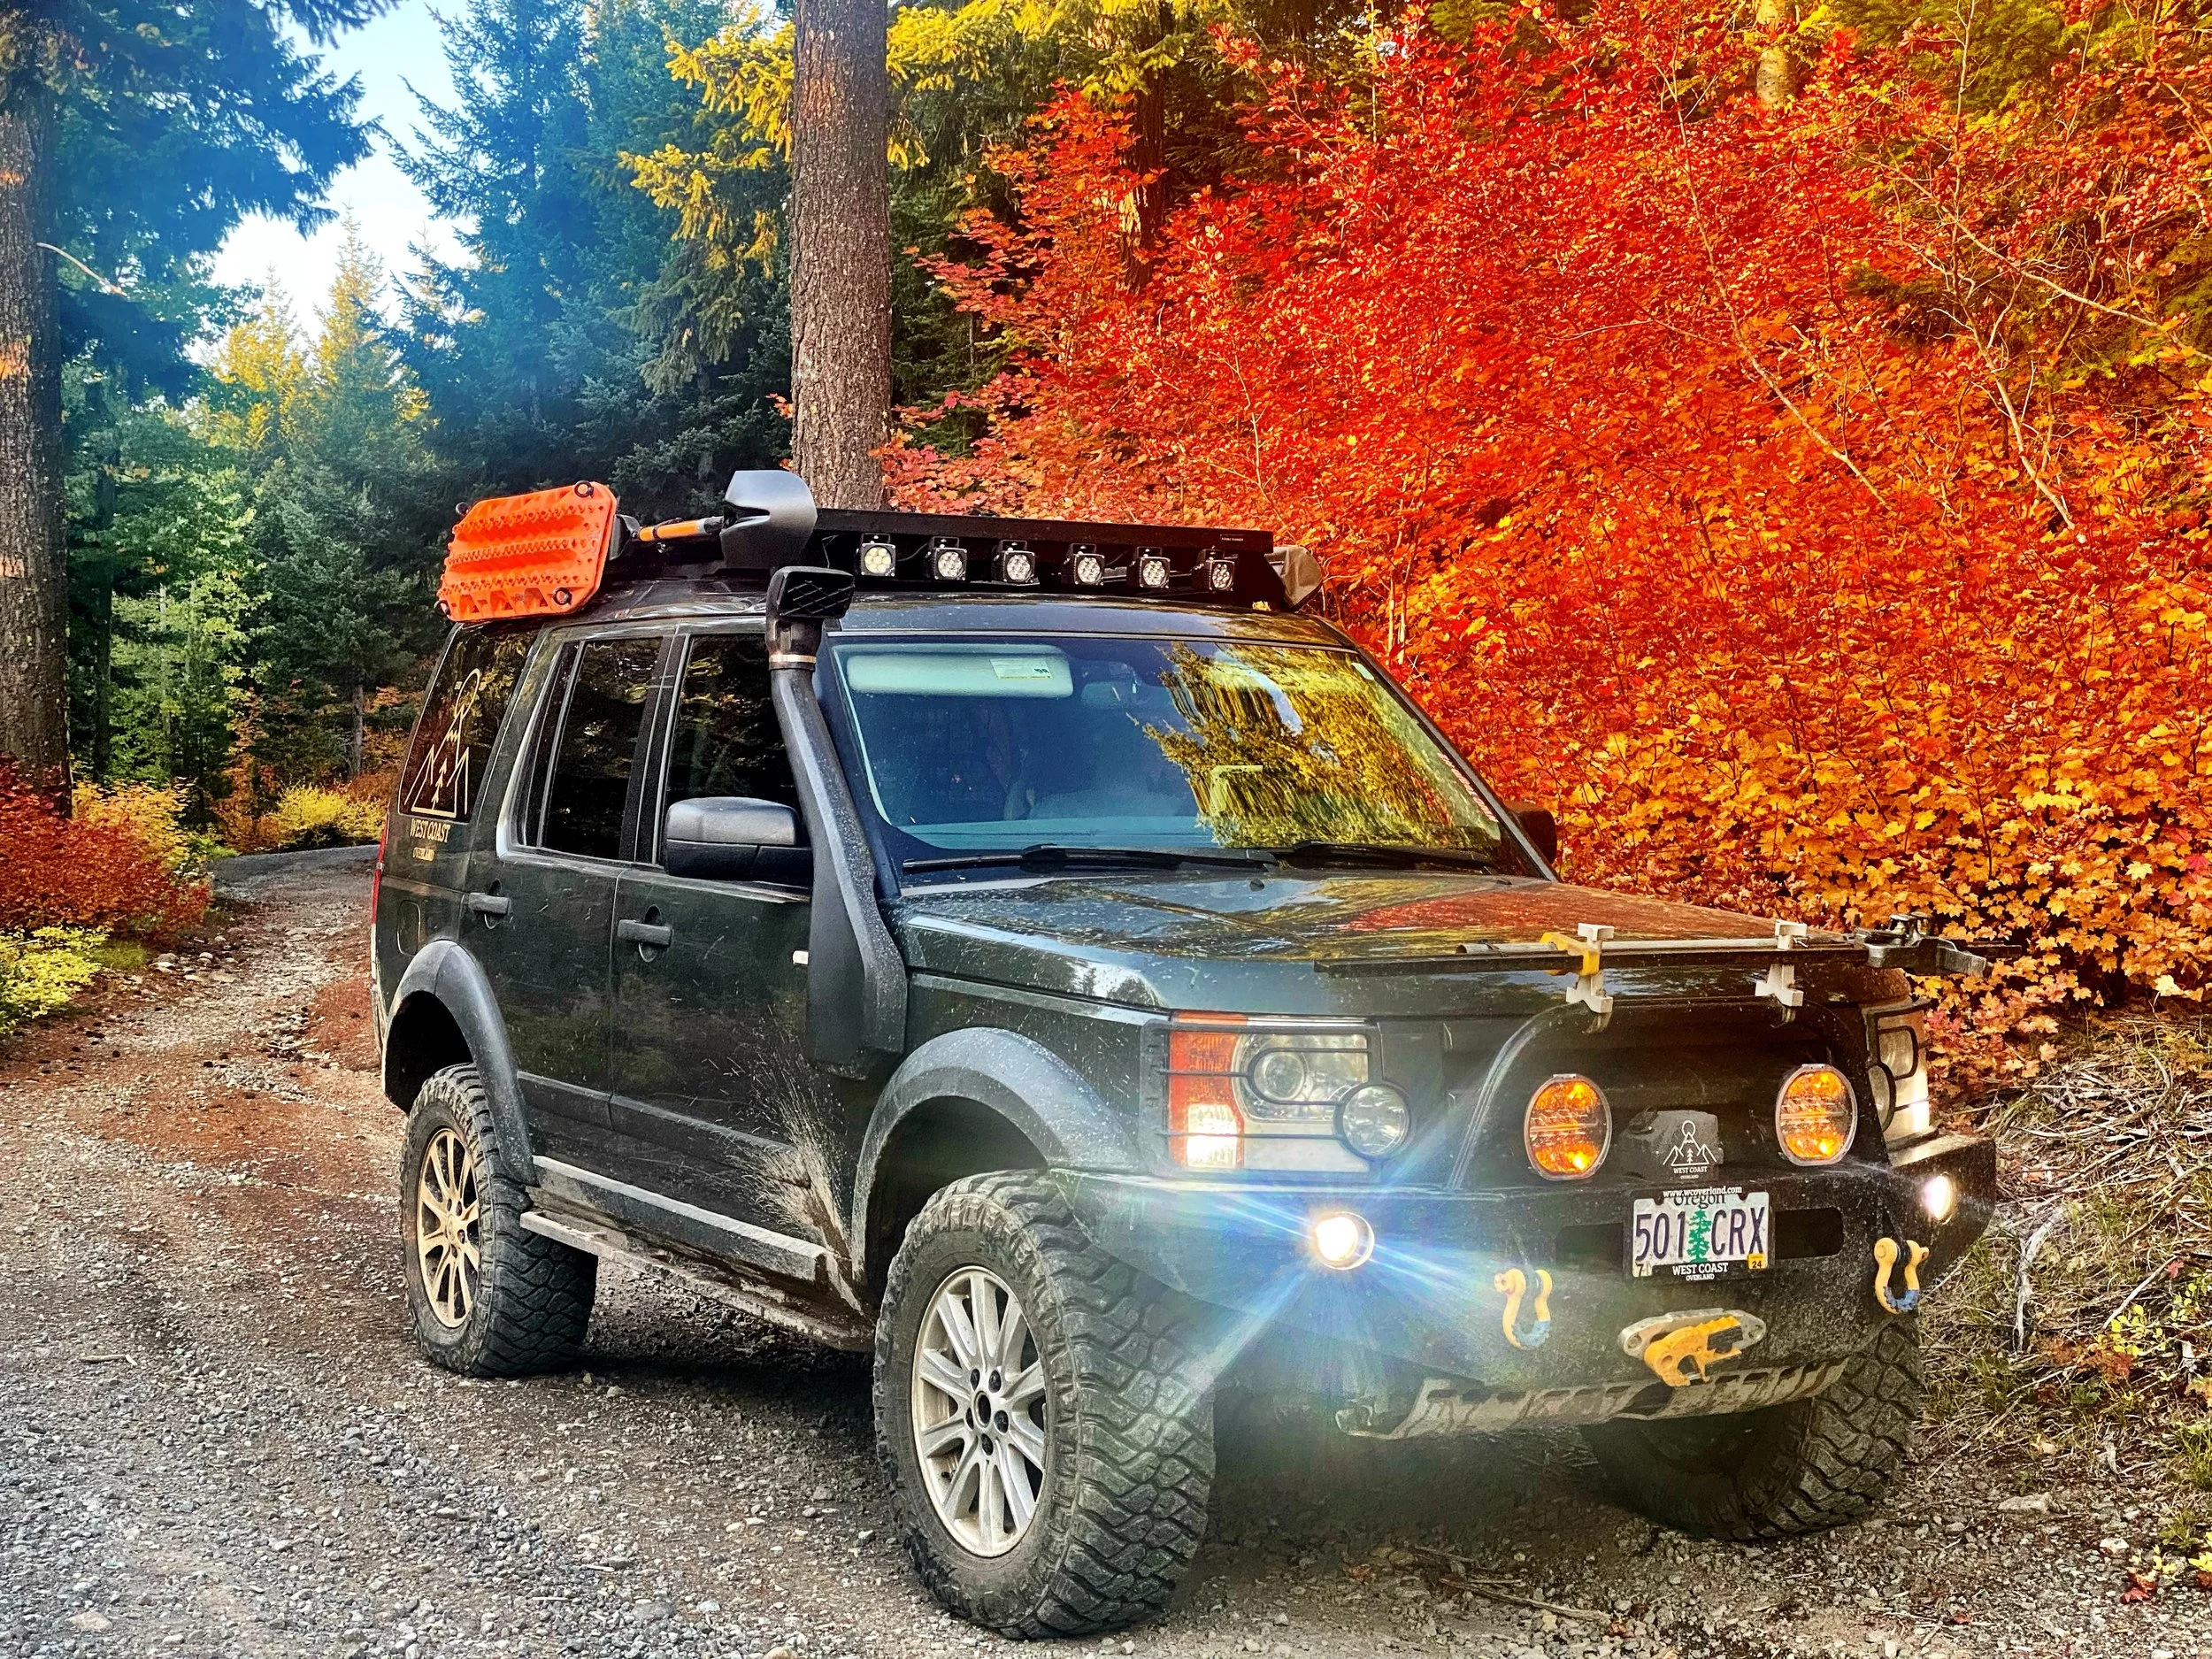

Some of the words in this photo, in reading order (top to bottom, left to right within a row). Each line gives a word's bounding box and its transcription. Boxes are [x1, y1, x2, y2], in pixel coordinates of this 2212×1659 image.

[410, 818, 428, 839] WEST
[426, 821, 451, 843] COAST
[1663, 1186, 1742, 1198] www.wcoverland.com
[1635, 1211, 1685, 1261] 501
[1711, 1207, 1765, 1255] CRX
[1672, 1264, 1697, 1276] WEST
[1698, 1263, 1728, 1274] COAST
[1752, 1260, 1762, 1269] 24
